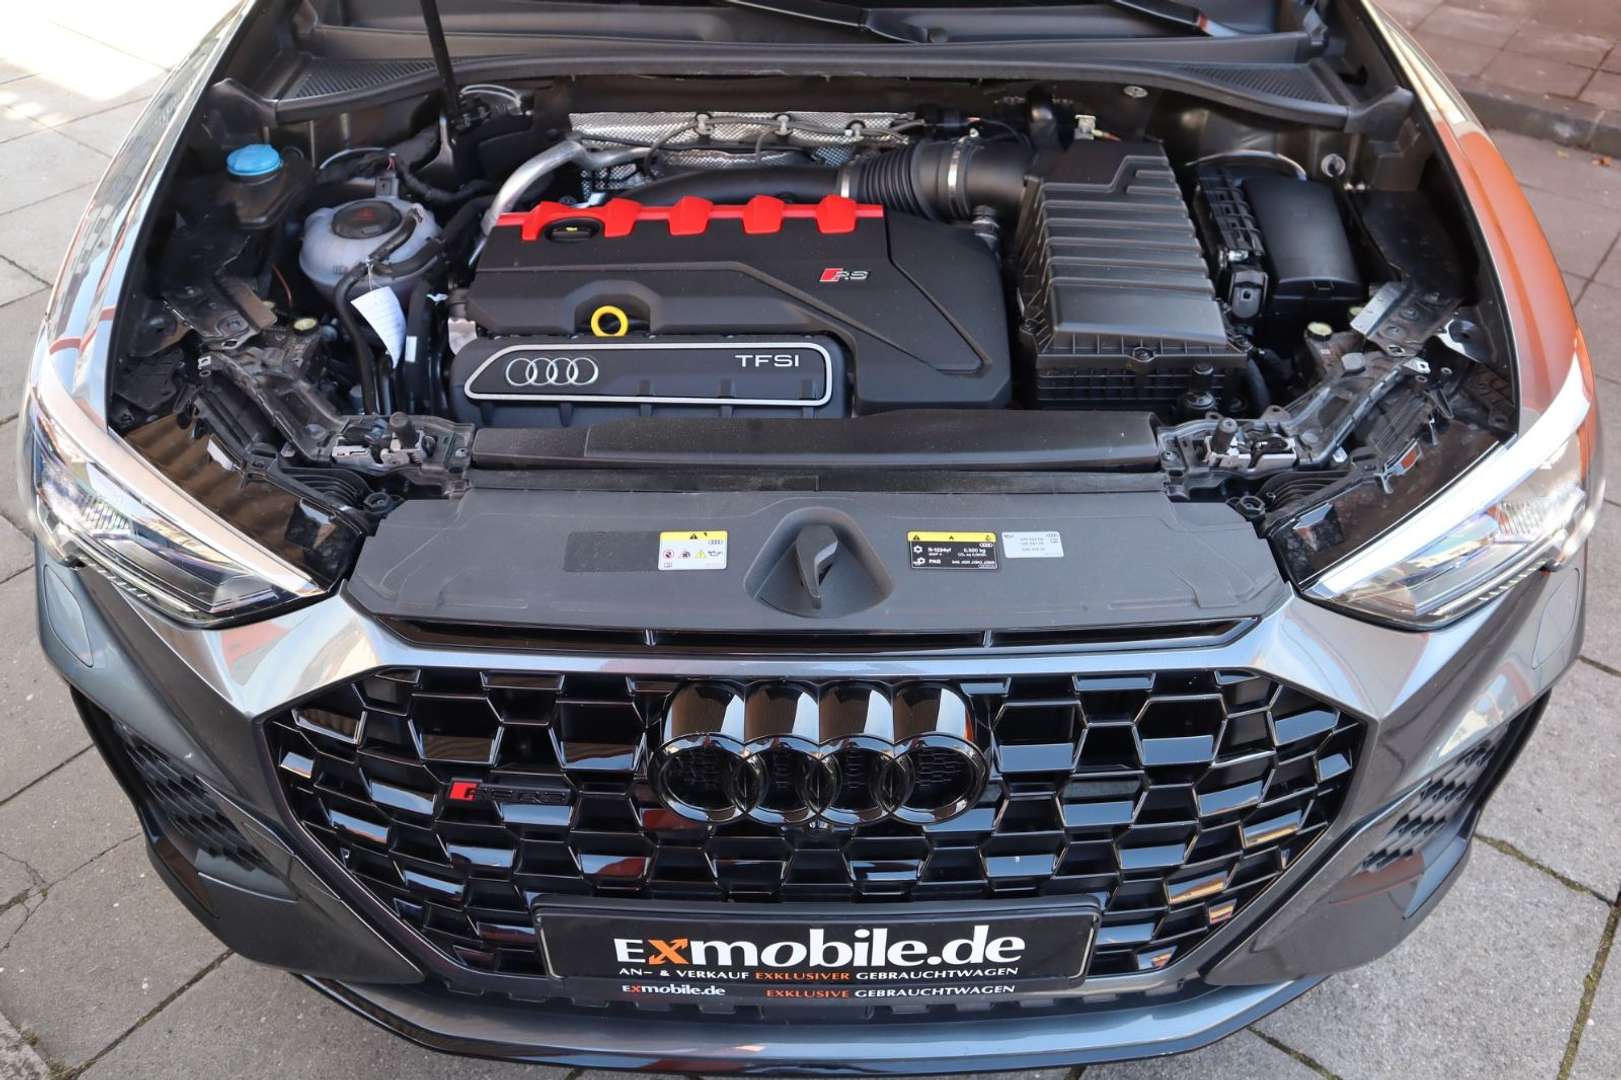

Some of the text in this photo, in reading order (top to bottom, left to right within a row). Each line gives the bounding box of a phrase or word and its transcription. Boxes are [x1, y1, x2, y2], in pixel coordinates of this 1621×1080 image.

[820, 268, 869, 282] RS
[735, 355, 800, 367] TFSI
[659, 969, 670, 978] &
[676, 969, 750, 981] VERKAUF
[755, 971, 850, 981] EXKLUSIVER
[856, 967, 1019, 981] GEBRAUCHTWAGEN
[766, 985, 1016, 999] EXKLUSIVE GEBRAUCHTWAGEN
